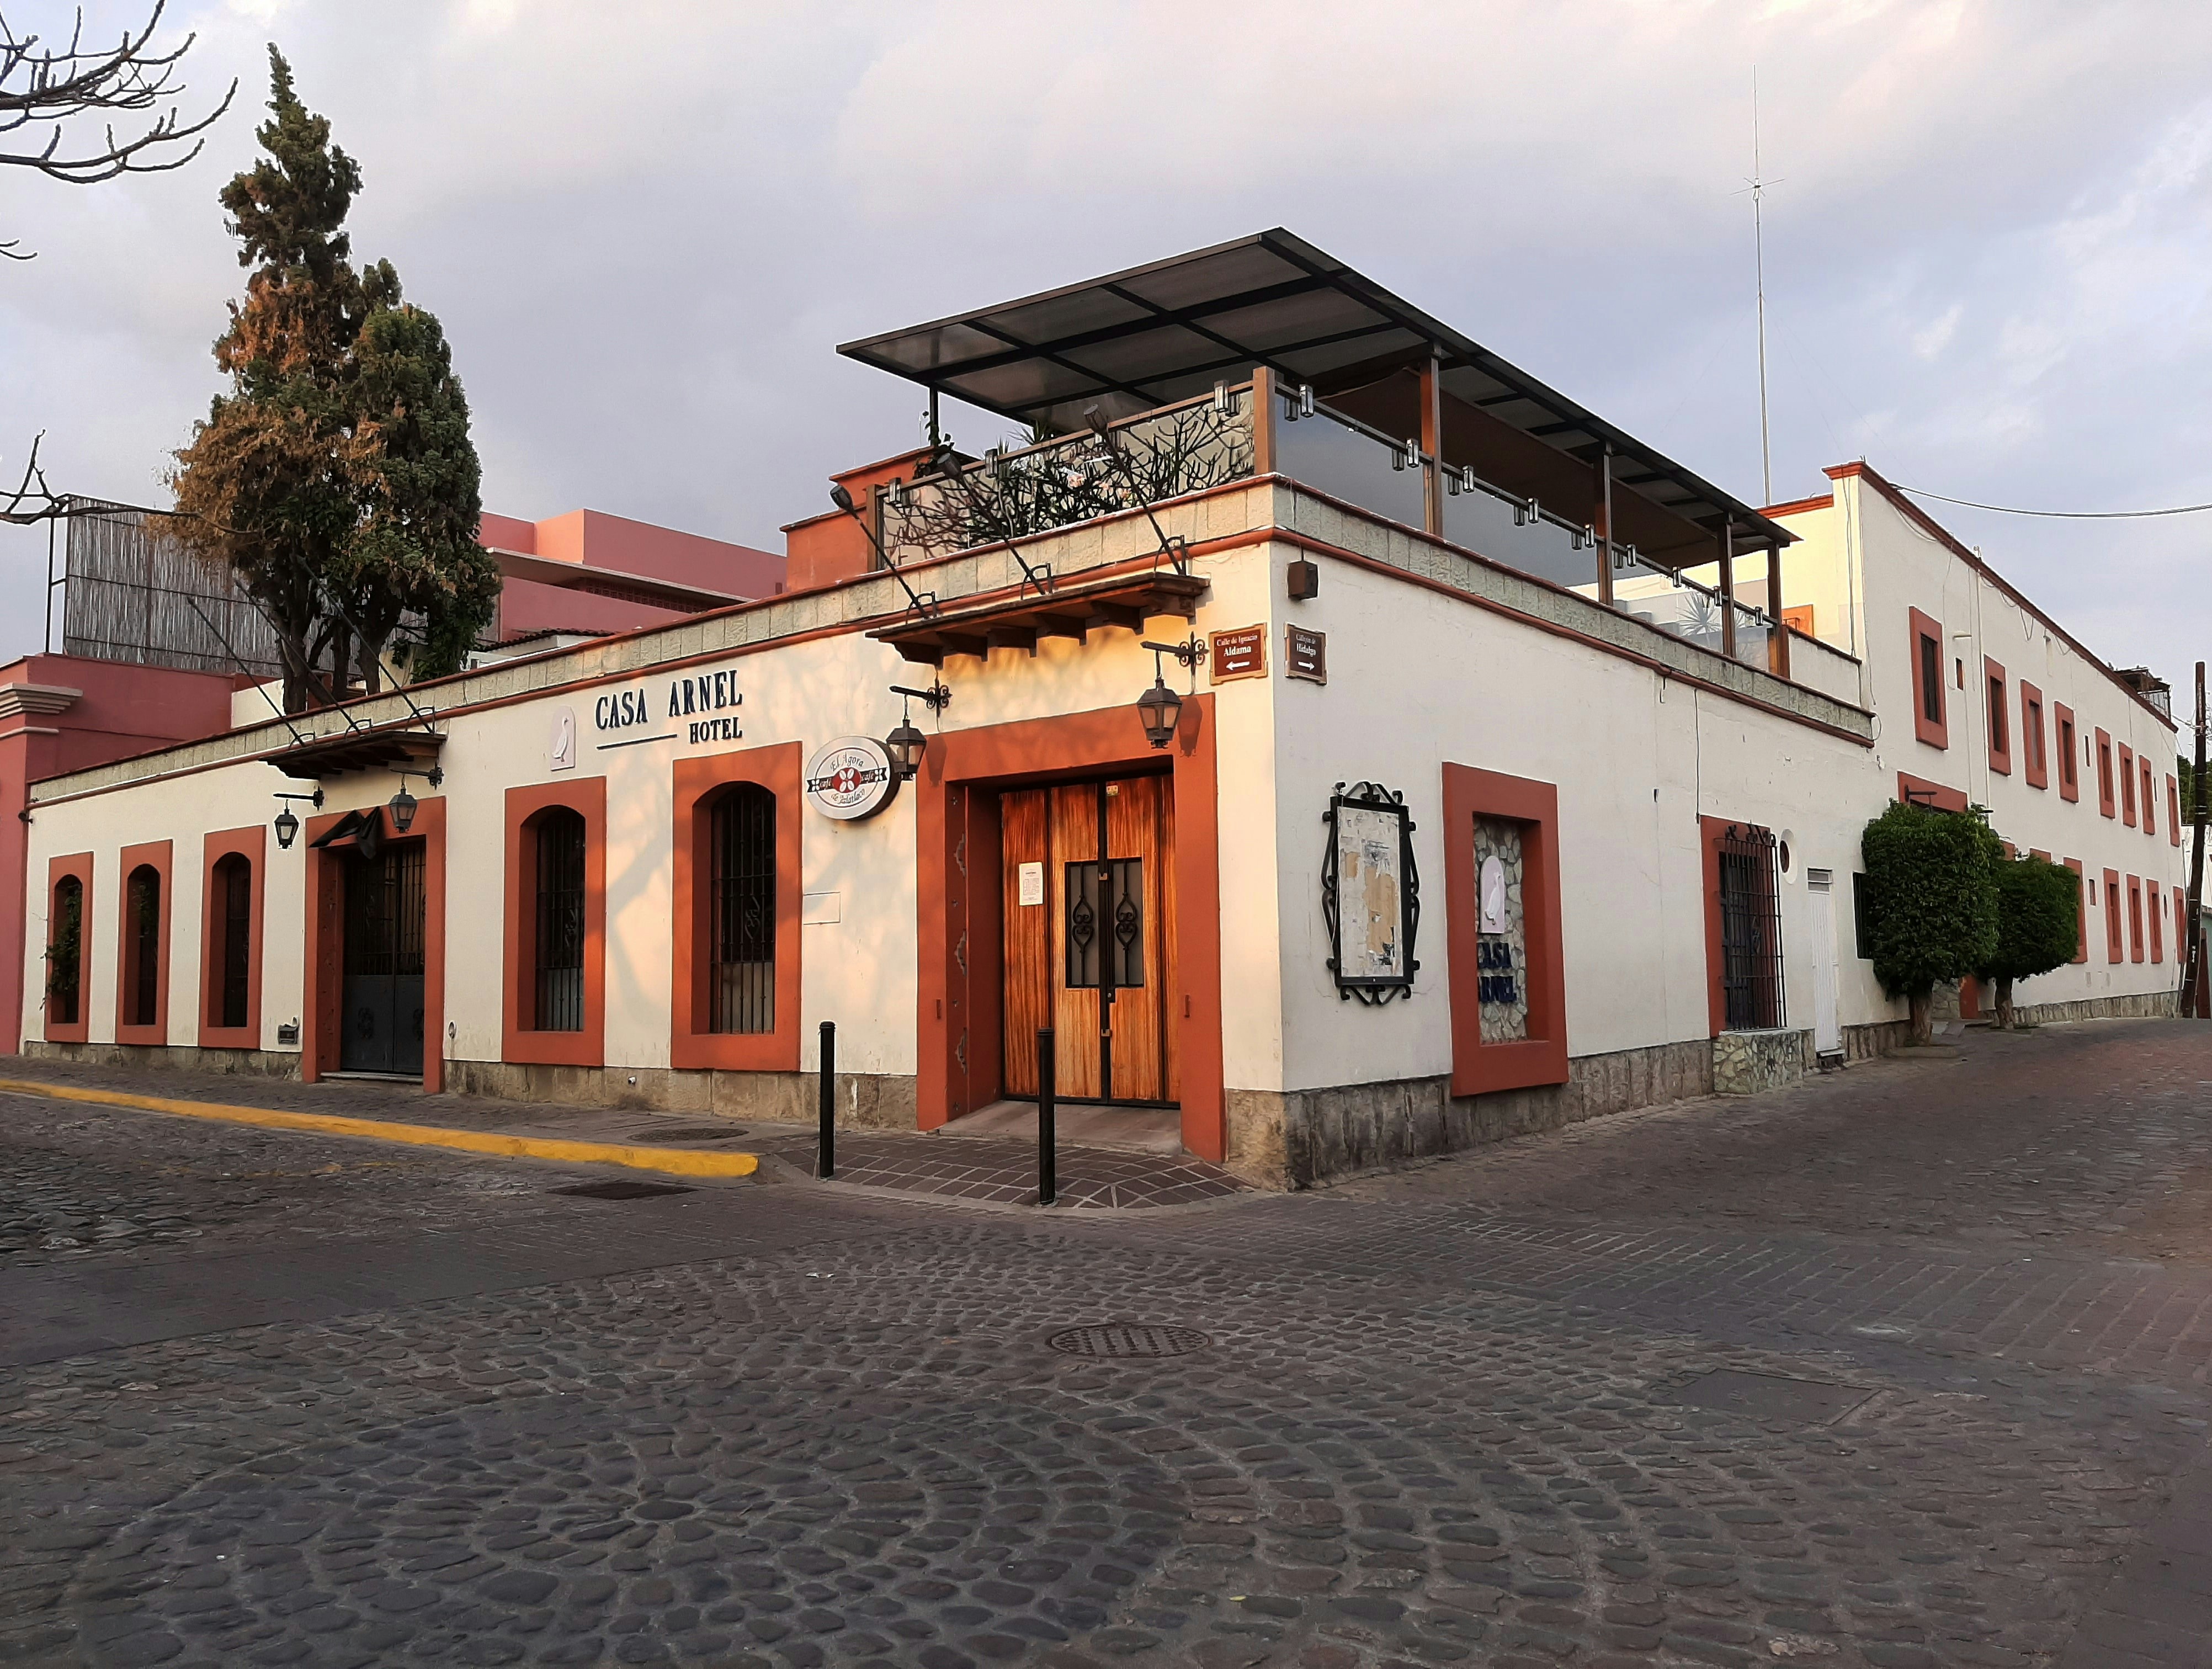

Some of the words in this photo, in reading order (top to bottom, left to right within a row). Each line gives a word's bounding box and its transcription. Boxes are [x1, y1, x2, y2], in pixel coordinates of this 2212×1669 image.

[1216, 638, 1230, 646] Calle
[1296, 643, 1316, 657] Hidalgo
[1223, 646, 1251, 657] Aldama
[595, 688, 647, 730] CASA
[668, 669, 742, 717] ARNEL
[689, 717, 742, 744] HOTEL
[830, 754, 839, 772] El
